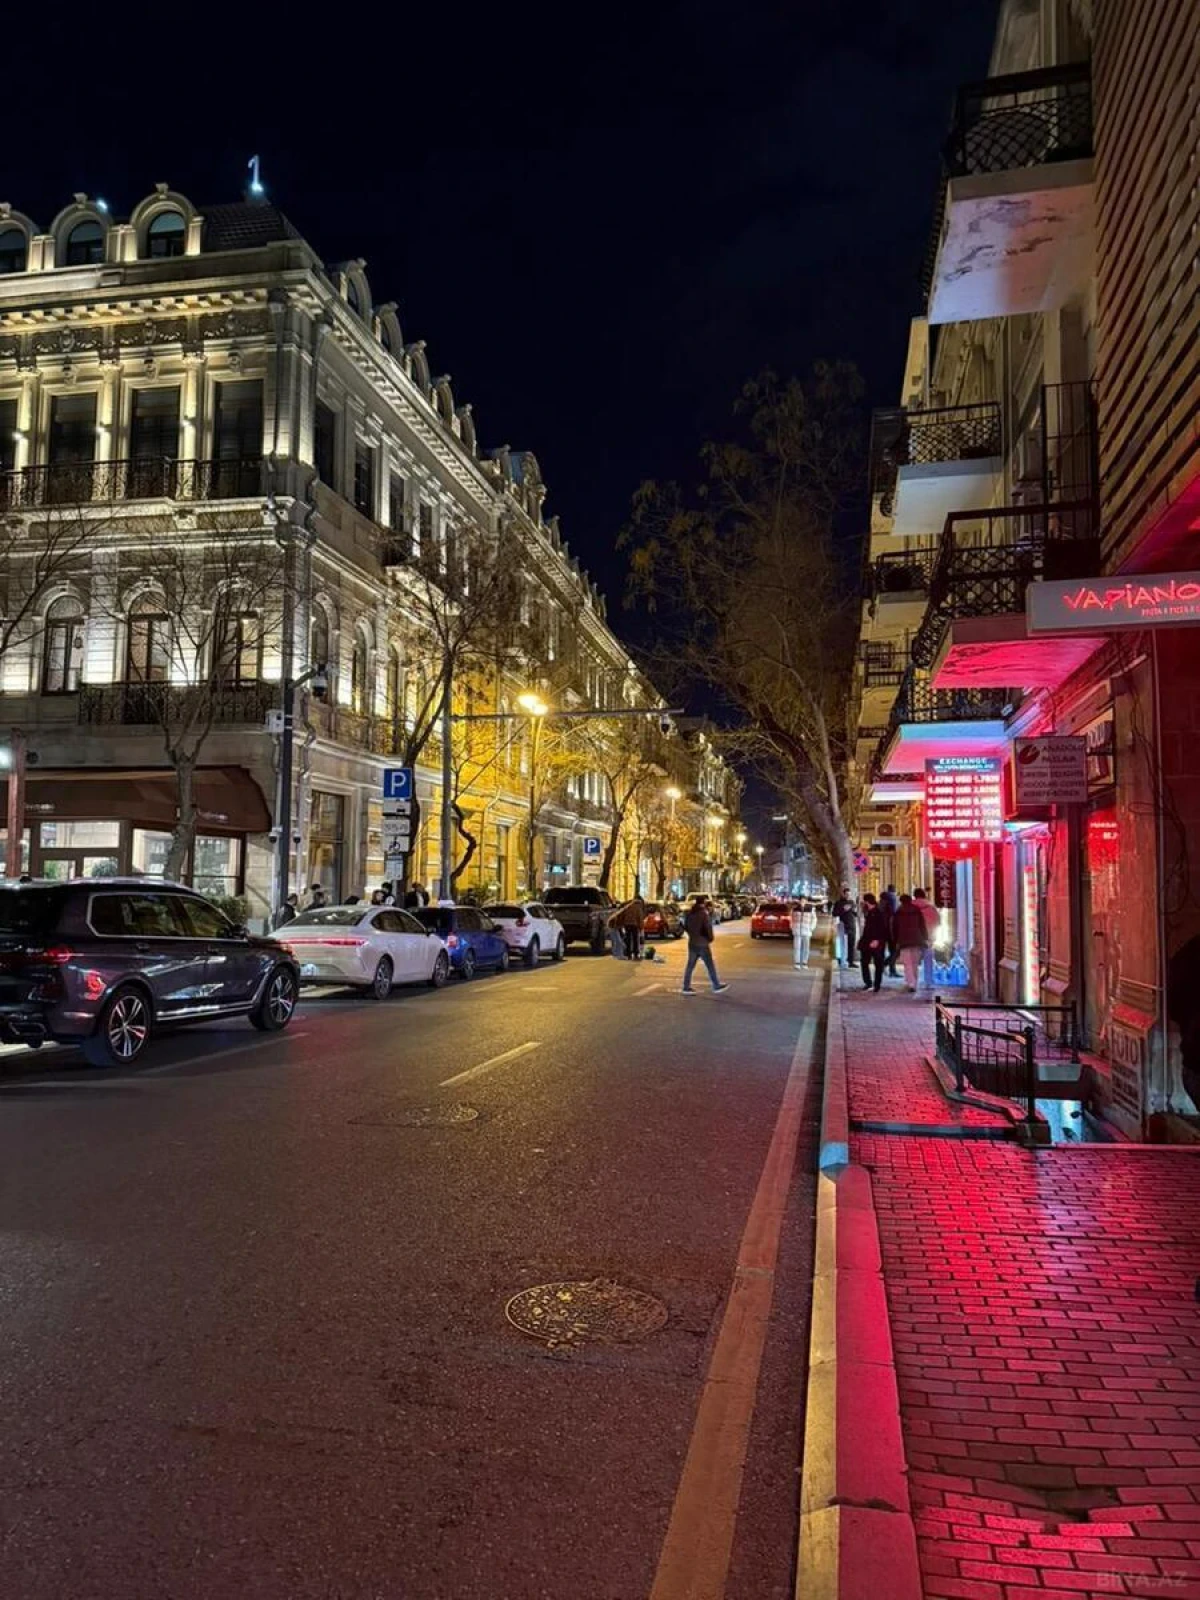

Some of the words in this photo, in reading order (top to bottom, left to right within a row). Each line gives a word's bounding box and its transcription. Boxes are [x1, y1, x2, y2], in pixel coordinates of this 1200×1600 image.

[1063, 580, 1200, 610] VAPIANO
[391, 771, 406, 795] P
[588, 839, 597, 853] P
